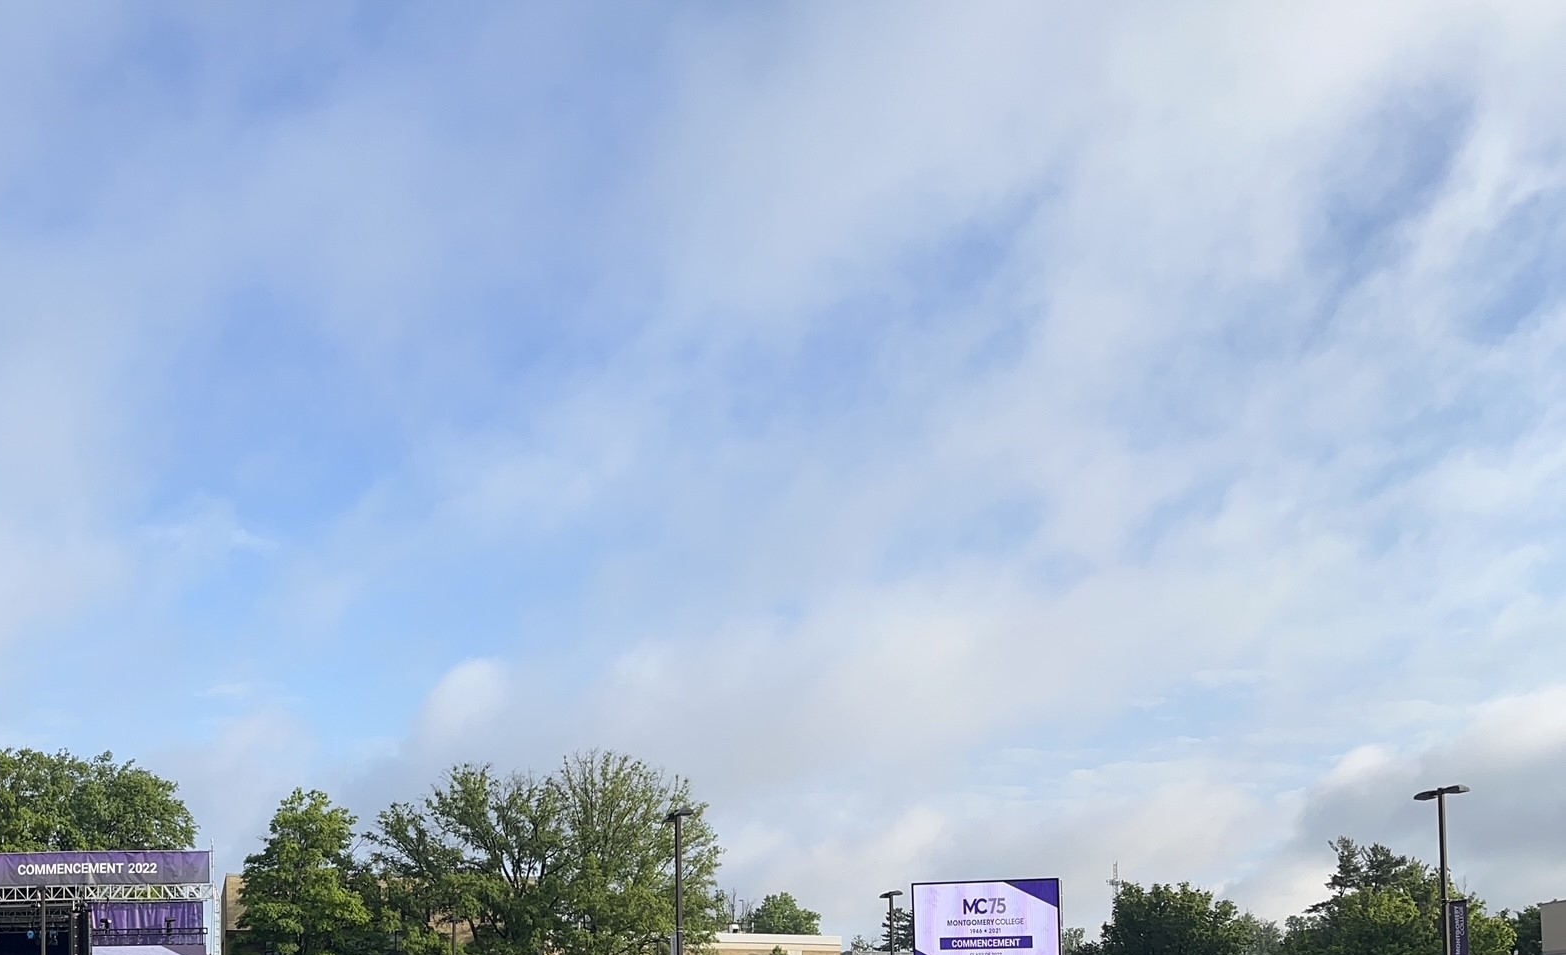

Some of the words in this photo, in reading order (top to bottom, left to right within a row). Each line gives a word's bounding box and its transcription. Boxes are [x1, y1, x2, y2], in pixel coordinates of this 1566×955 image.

[17, 862, 124, 876] COMMENCEMENT
[128, 862, 158, 874] 2022
[963, 898, 1007, 915] MC75
[1454, 905, 1462, 955] MONTGOMERY
[952, 938, 1021, 948] COMMENCEMENT
